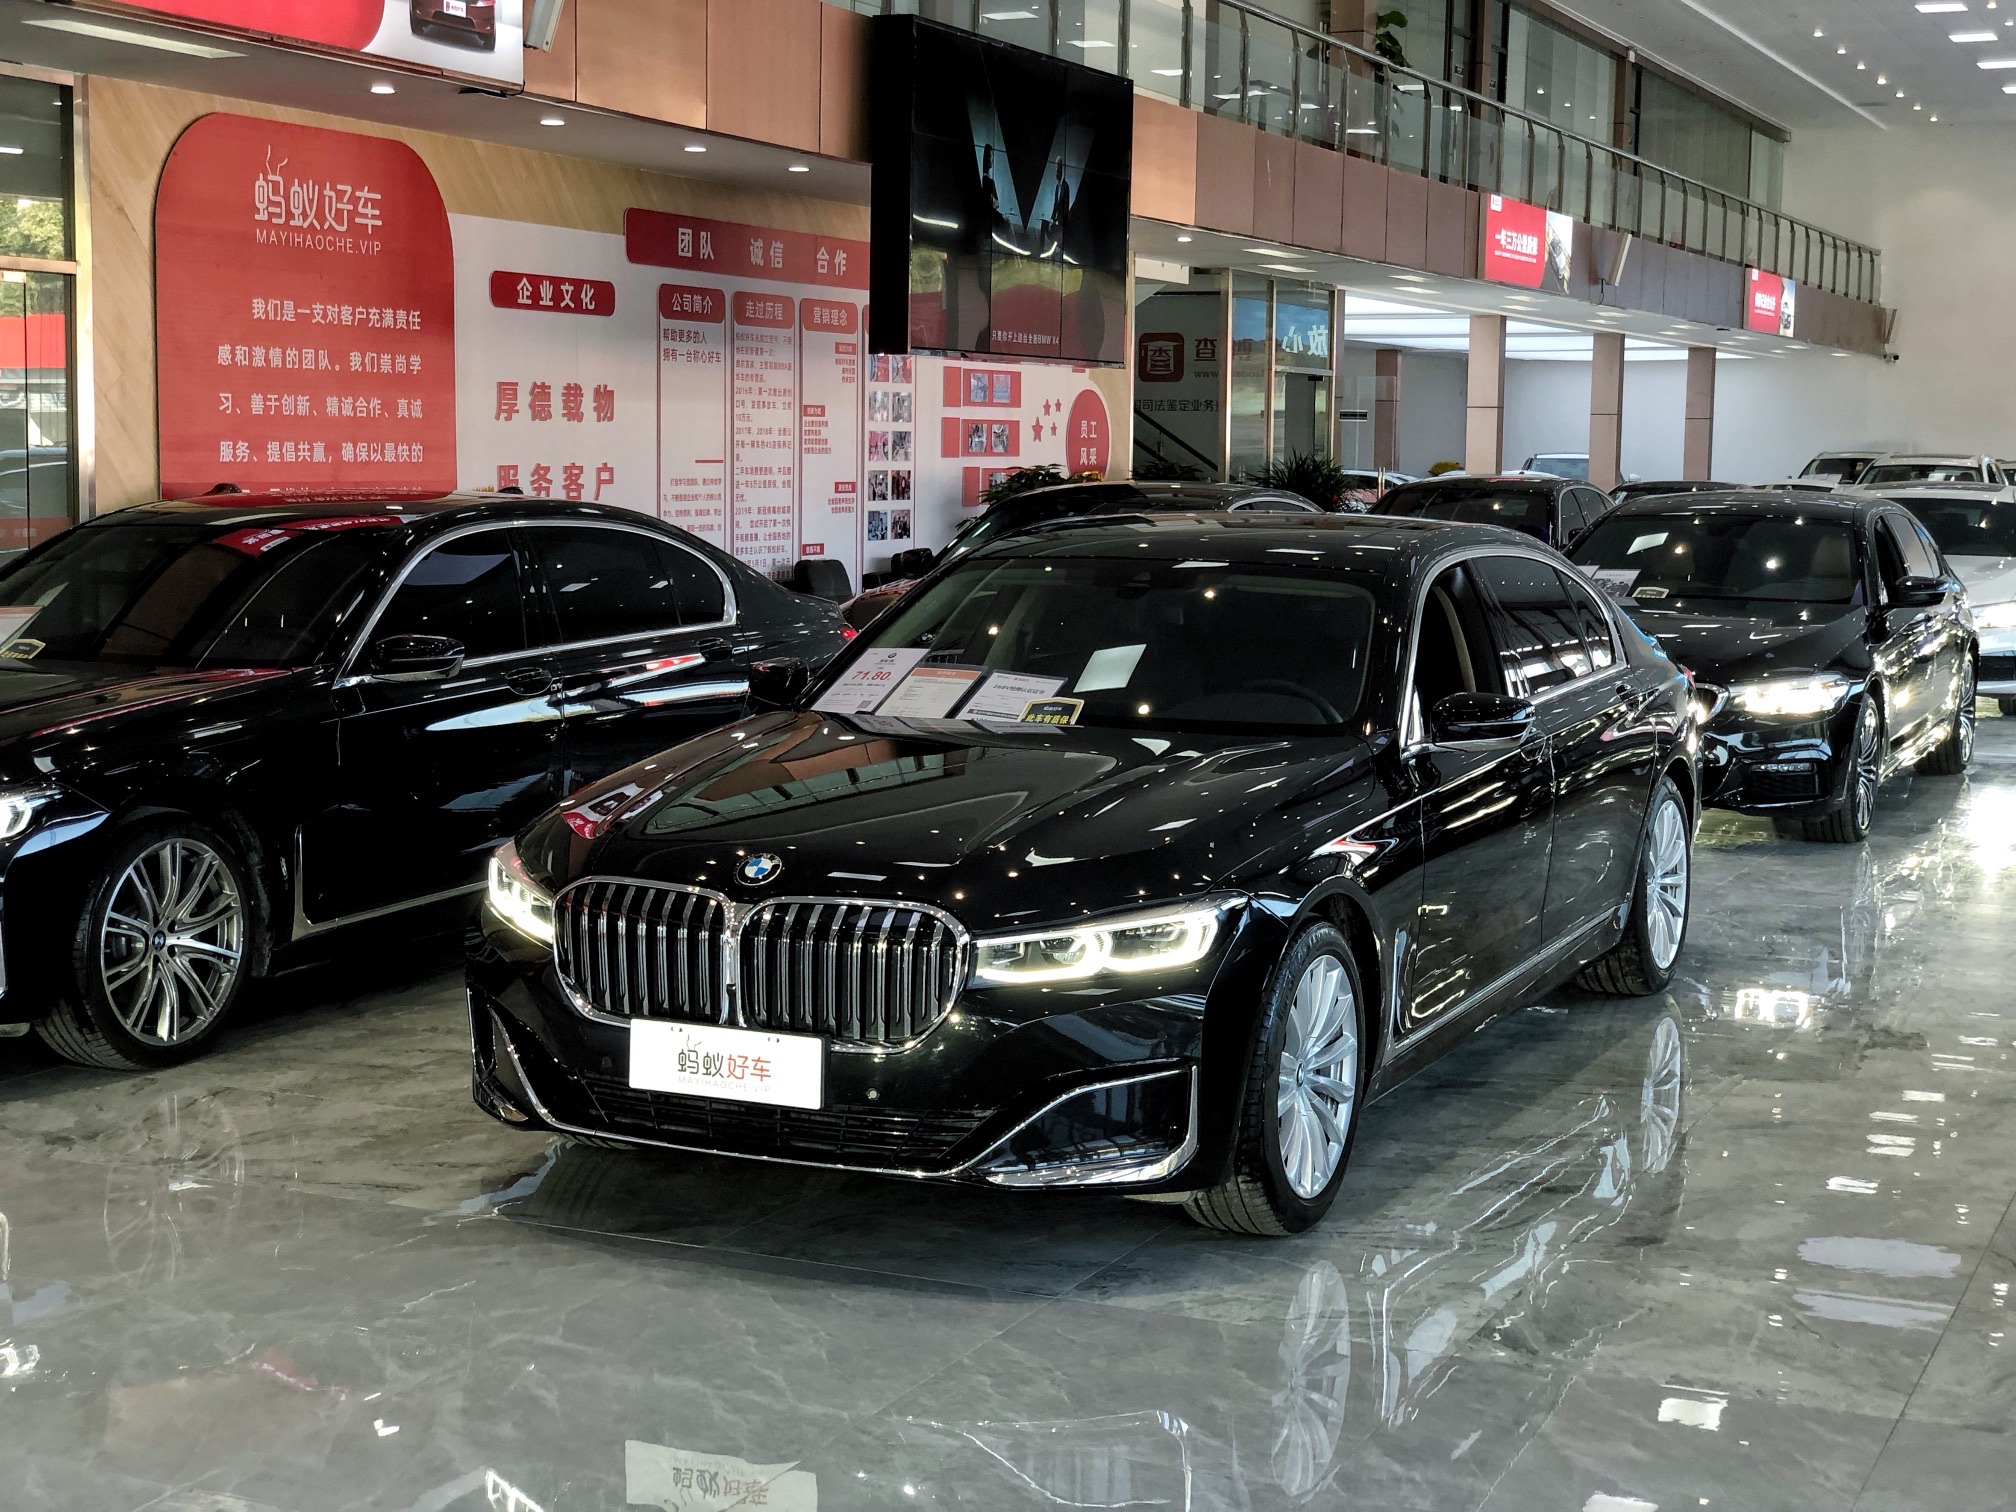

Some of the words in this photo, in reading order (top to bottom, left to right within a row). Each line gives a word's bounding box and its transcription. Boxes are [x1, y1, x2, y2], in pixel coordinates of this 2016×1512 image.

[254, 172, 383, 235] 蚂蚁好车
[255, 228, 382, 256] MAYIHAOCHE.VIP
[678, 228, 714, 260] 团队
[750, 238, 784, 269] 诚信
[816, 246, 847, 276] 合作
[516, 277, 595, 310] 企业文化
[672, 293, 712, 314] 公司简介
[252, 297, 422, 330] 我们是一支对客户充满责任
[745, 301, 784, 320] 走过历程
[813, 306, 848, 326] 营销理念
[663, 328, 707, 344] 帮助更多的人
[217, 343, 422, 375] 感和激情的团队。我们崇尚学
[663, 348, 721, 364] 拥有一台称心好车
[1194, 338, 1218, 361] 查
[219, 392, 423, 419] 习、善于创新、精诚合作、真诚
[494, 381, 615, 422] 厚德载物
[1080, 420, 1098, 439] 员工
[219, 440, 423, 464] 服务、提倡共赢，确保以最快的
[1079, 447, 1098, 466] 风采
[496, 462, 615, 501] 服务客户
[1026, 714, 1070, 724] 此车有质保
[678, 1047, 771, 1082] 蚂蚁好车
